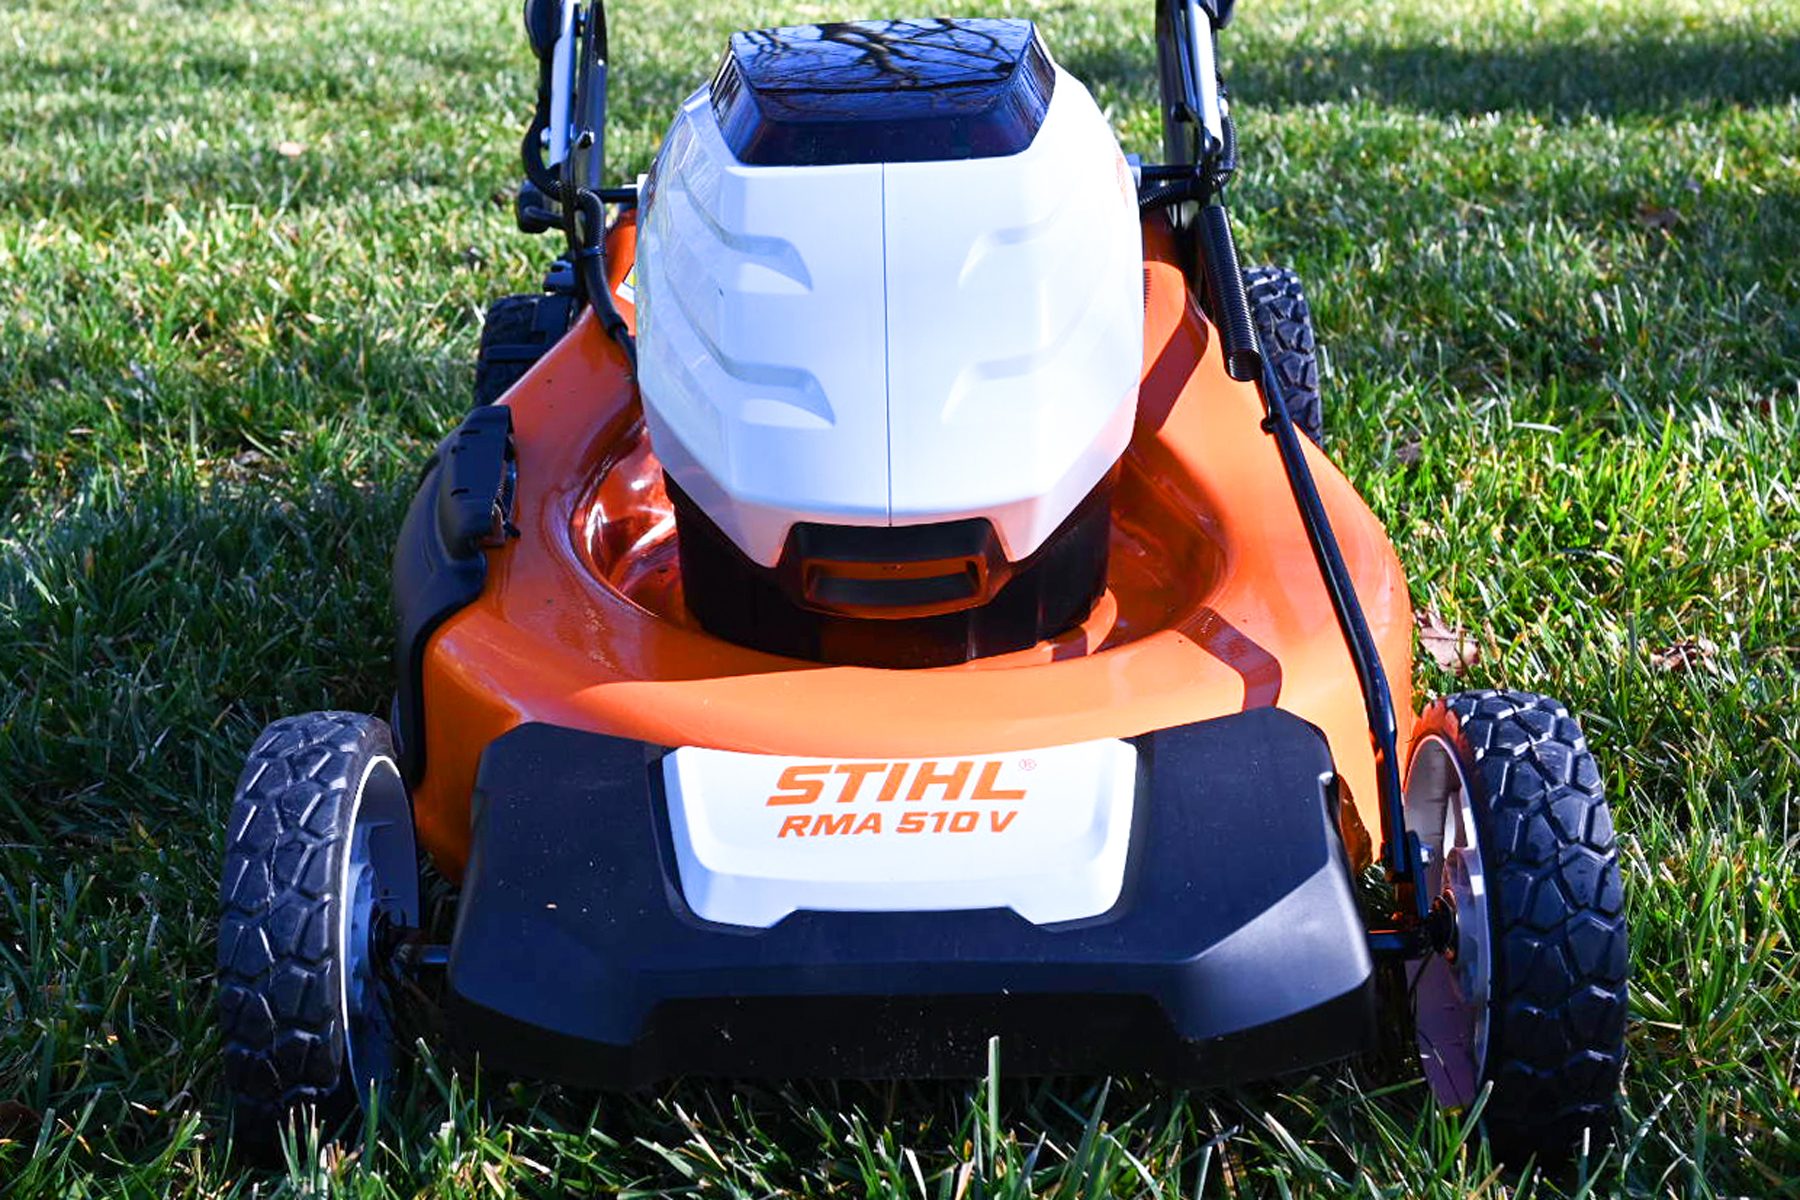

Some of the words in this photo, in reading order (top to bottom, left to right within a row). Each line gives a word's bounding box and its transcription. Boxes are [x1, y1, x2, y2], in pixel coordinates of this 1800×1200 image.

[777, 812, 882, 838] RMA
[895, 811, 980, 833] 510
[990, 811, 1018, 833] V
